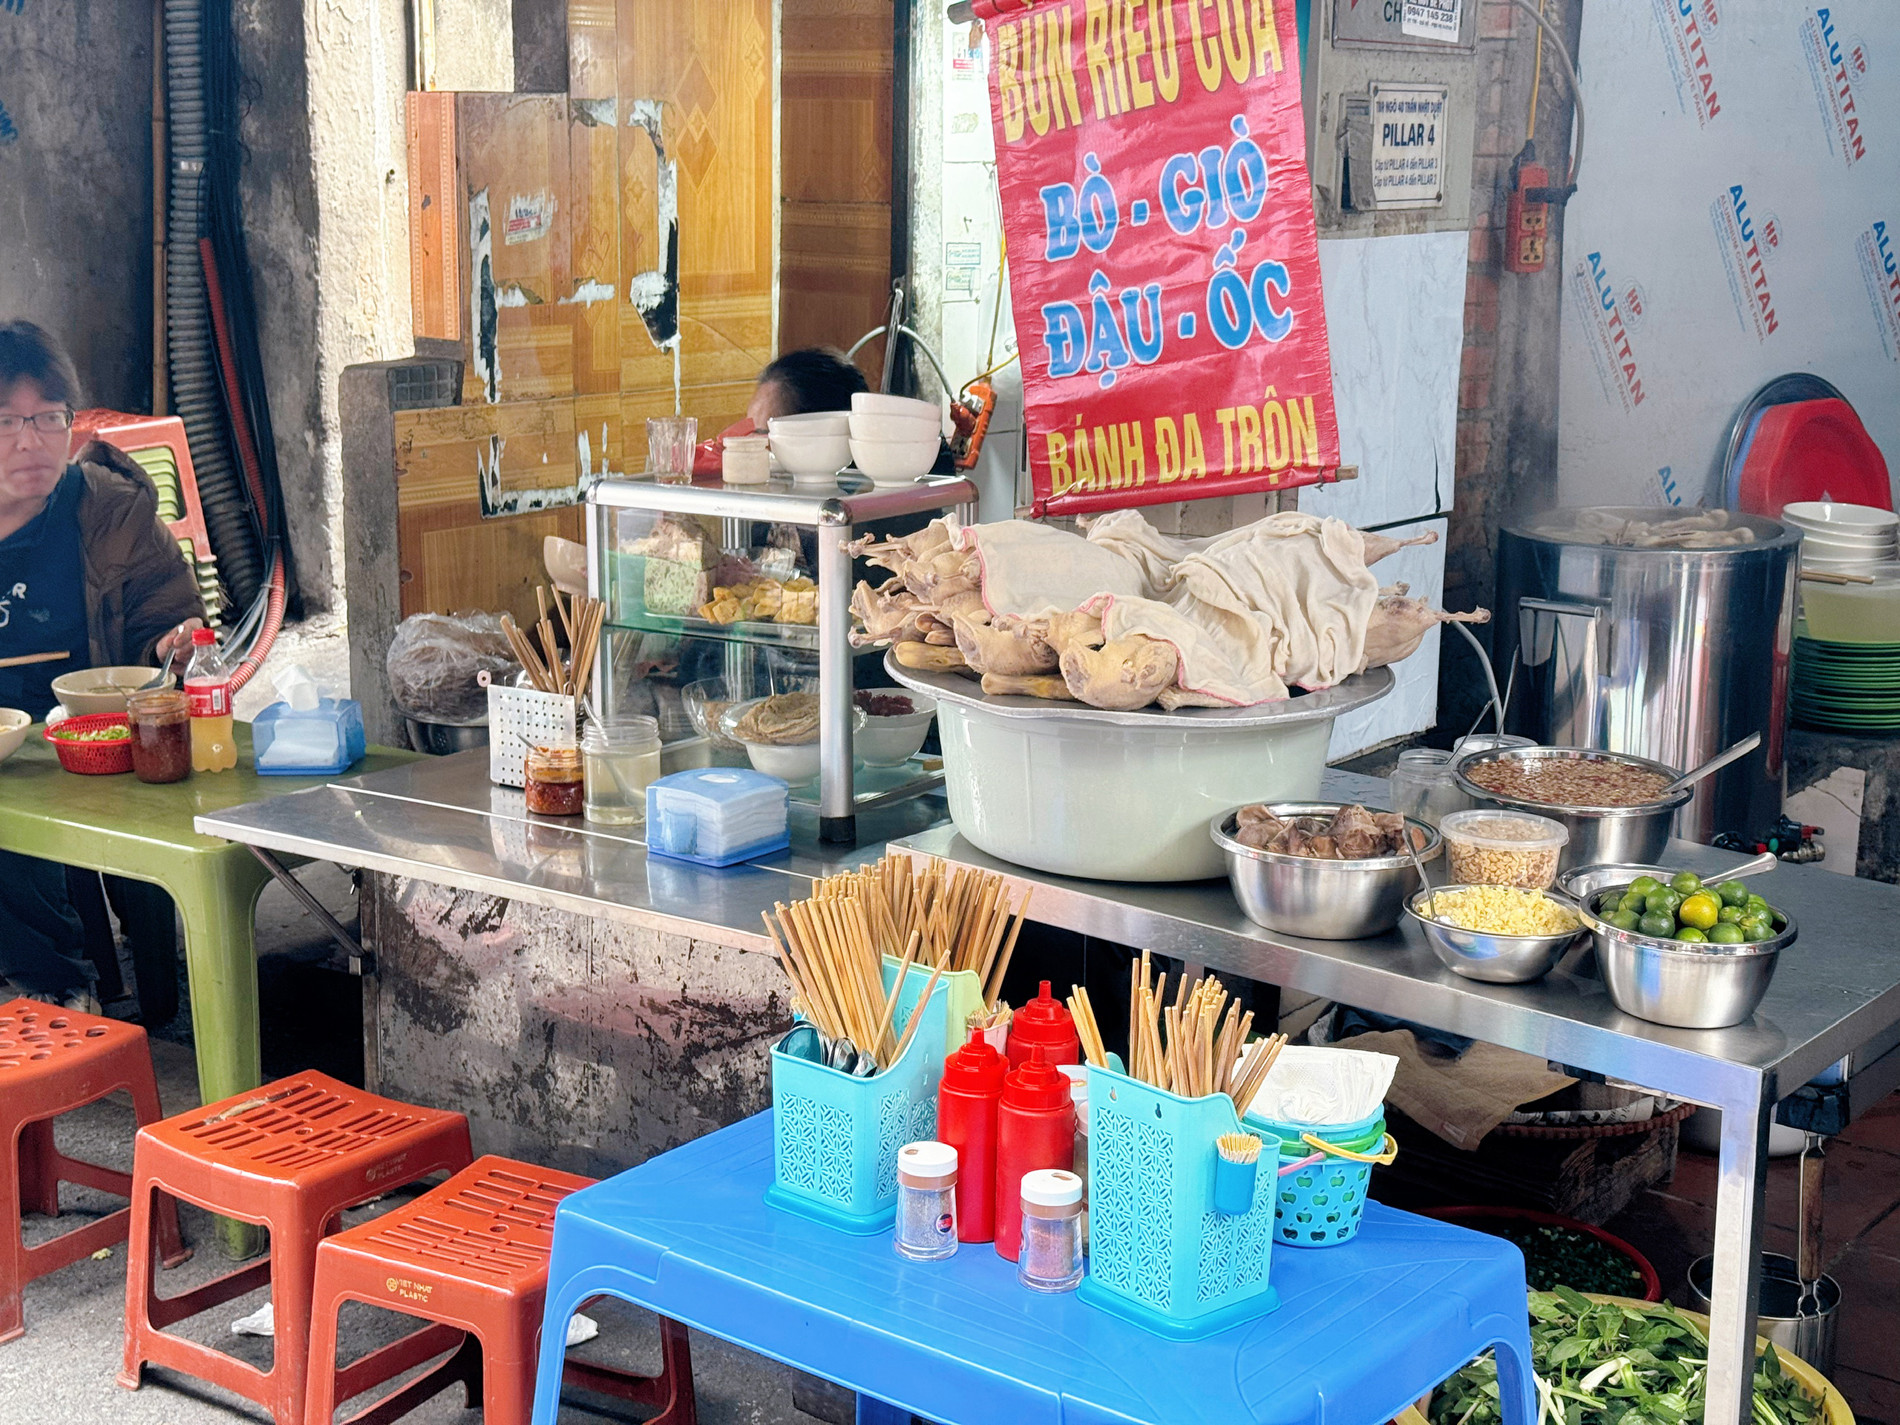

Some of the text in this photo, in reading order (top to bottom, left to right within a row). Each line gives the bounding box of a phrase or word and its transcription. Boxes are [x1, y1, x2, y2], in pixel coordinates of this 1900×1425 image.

[1383, 0, 1403, 23] CH
[1817, 8, 1866, 161] ALUTITAN
[1825, 75, 1844, 136] COMPOSITE
[1382, 123, 1435, 147] PILLAR 4
[1389, 158, 1405, 170] PILLAR
[1418, 157, 1434, 169] PILLAR
[1039, 152, 1120, 261] BÒ
[1158, 114, 1269, 236] GIÒ
[1388, 174, 1404, 186] PILLAR
[1417, 173, 1433, 186] PILLAR
[1720, 194, 1738, 250] ALUMINUM
[1735, 251, 1755, 311] COMPOSITE
[1730, 184, 1779, 336] ALUTITAN
[1042, 269, 1164, 389] ĐẬU
[1207, 228, 1294, 350] ỐC
[1587, 251, 1646, 406] ALUTITAN
[1627, 288, 1642, 317] HP
[1045, 386, 1319, 495] BÁNH ĐA TRỘN
[399, 1288, 428, 1303] PLASTIC
